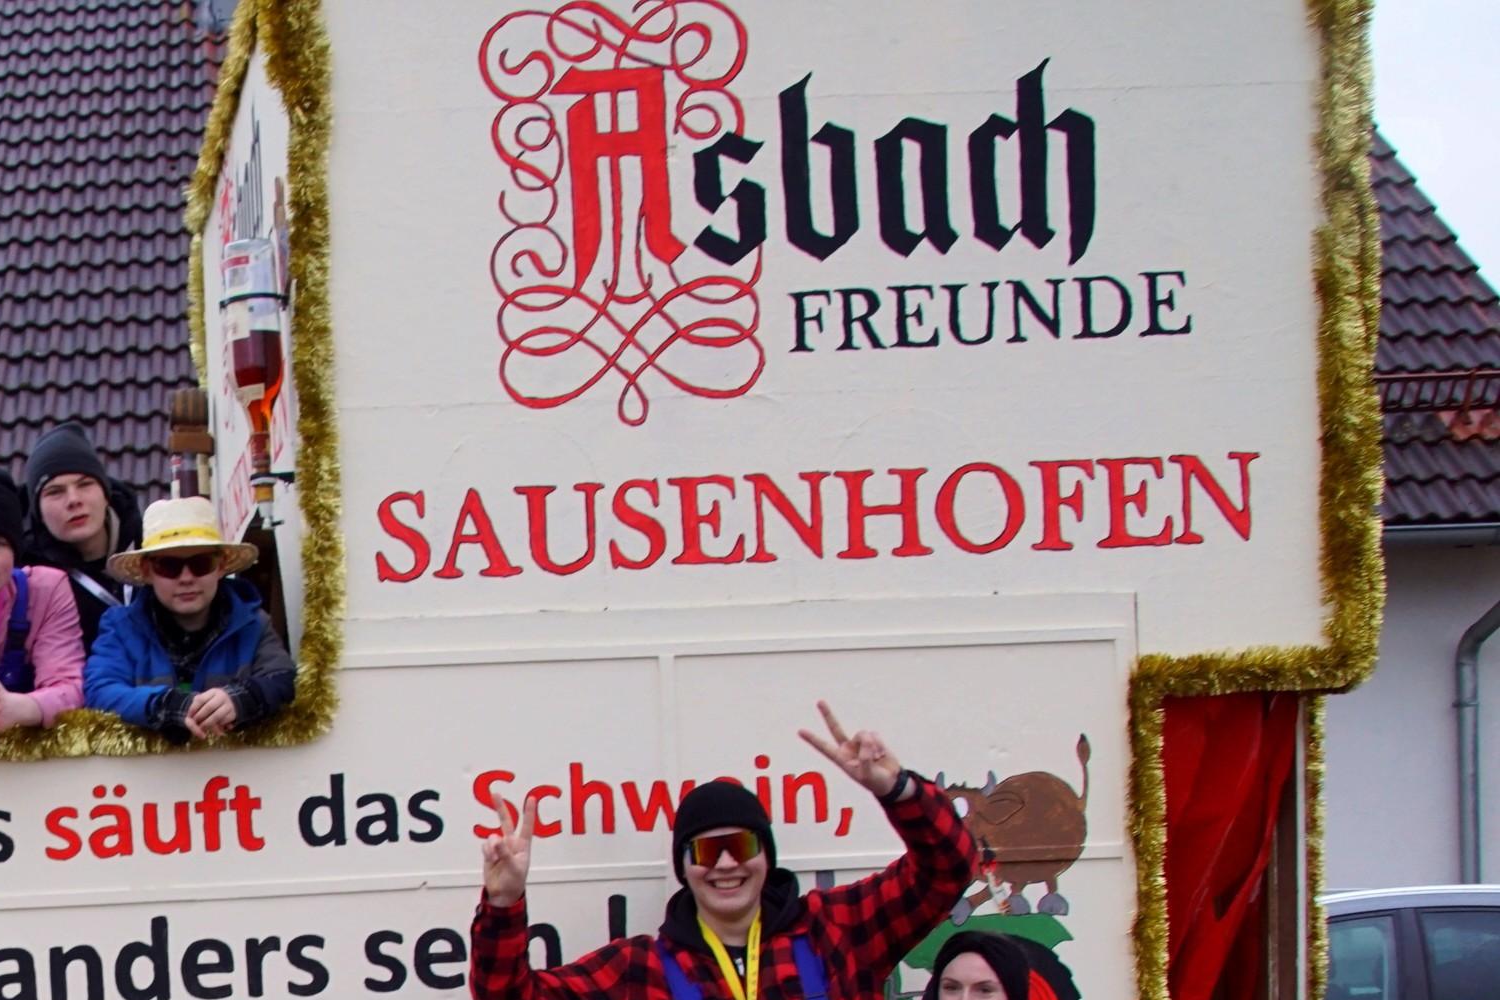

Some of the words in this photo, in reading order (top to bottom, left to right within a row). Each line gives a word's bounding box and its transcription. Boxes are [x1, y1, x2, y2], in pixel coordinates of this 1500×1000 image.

[550, 57, 1096, 290] Asbach
[788, 270, 1192, 353] FREUNDE
[375, 452, 1258, 582] SAUSENHOFEN
[44, 776, 266, 861] säuft
[298, 772, 444, 848] das
[472, 755, 853, 840] Schwin,
[364, 922, 563, 993] sen
